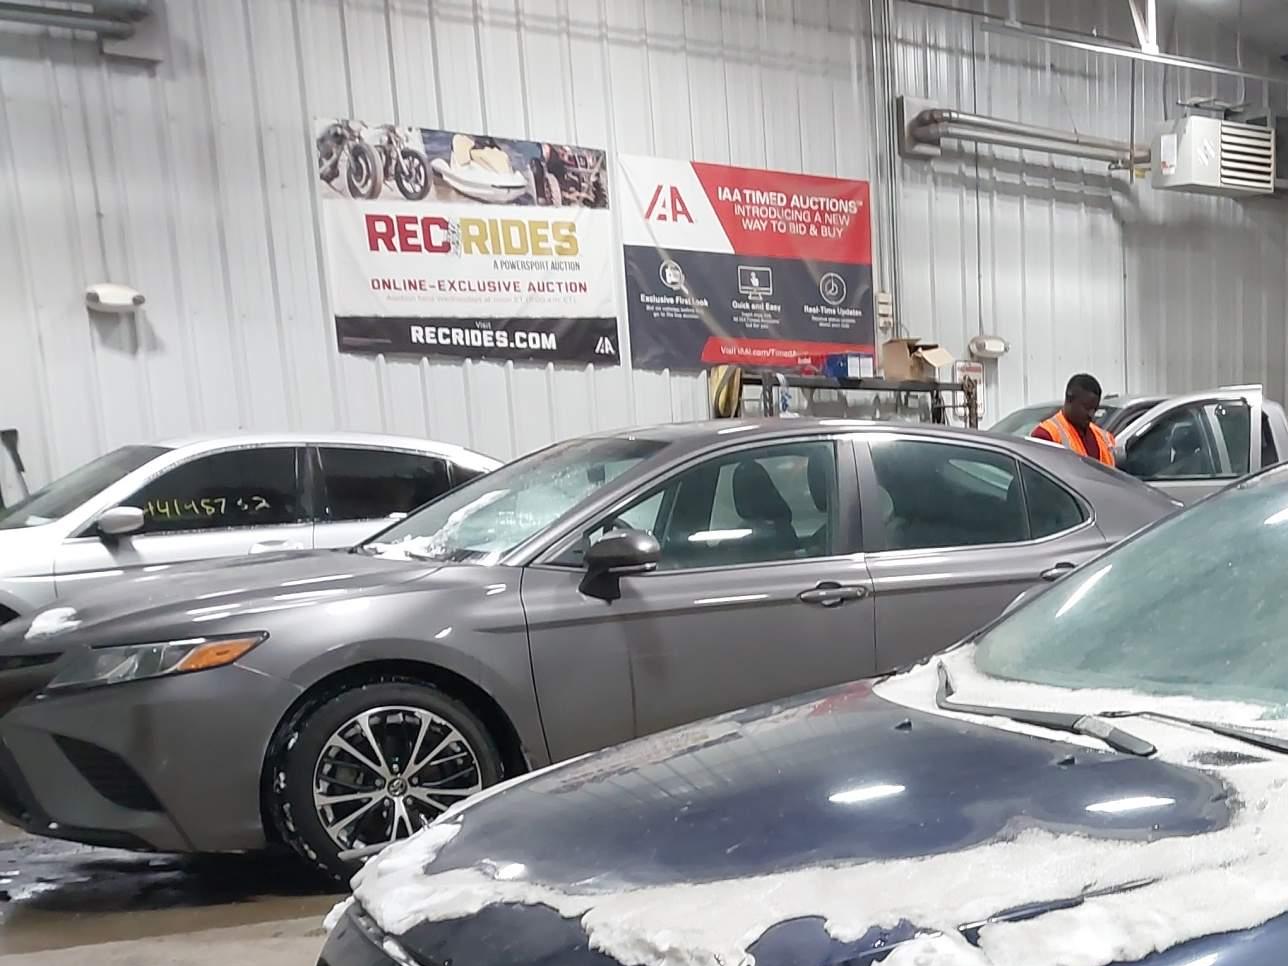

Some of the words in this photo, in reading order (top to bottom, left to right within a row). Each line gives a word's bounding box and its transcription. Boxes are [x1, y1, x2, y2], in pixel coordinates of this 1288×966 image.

[718, 187, 742, 203] IAA
[743, 189, 786, 206] TIMED
[734, 204, 811, 222] INTRODUCING
[814, 213, 822, 223] A
[825, 215, 850, 226] NEW
[365, 214, 450, 253] REC
[459, 217, 580, 256] RIDES
[742, 220, 768, 231] WAY
[771, 221, 786, 233] TO
[789, 223, 806, 235] BID
[810, 226, 818, 236] &
[821, 226, 844, 238] BUY
[493, 260, 498, 270] A
[500, 260, 549, 271] POWERSPORT
[550, 261, 580, 271] AUCTION
[371, 278, 521, 293] ONLINE-EXCLUSIVE
[528, 280, 588, 293] AUCTION
[640, 293, 674, 304] Exclusive
[732, 300, 750, 310] Quick
[751, 302, 764, 310] and
[765, 302, 781, 312] Easy
[803, 305, 836, 316] Real-Time
[837, 307, 862, 317] Updates
[475, 320, 491, 329] Visit
[411, 326, 557, 350] RECRIDES.COM
[720, 345, 736, 355] Visit
